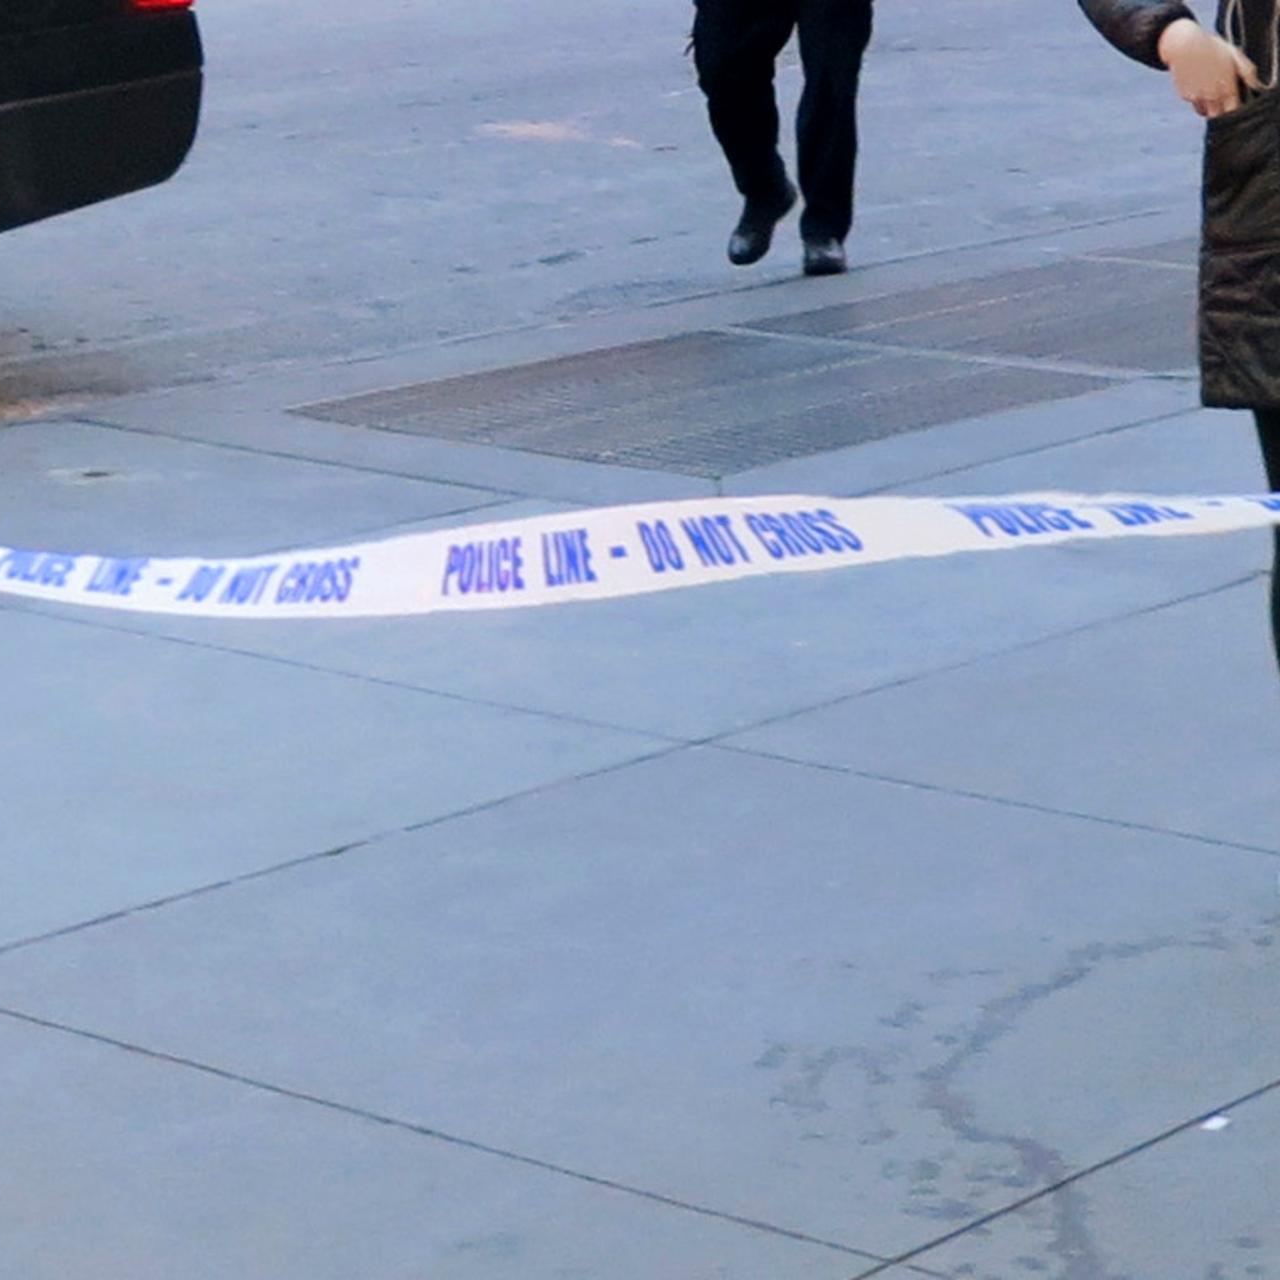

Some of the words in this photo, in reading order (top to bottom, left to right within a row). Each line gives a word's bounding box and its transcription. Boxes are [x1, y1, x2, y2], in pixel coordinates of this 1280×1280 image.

[441, 535, 526, 596] POLICE
[541, 528, 598, 588] LINE
[636, 518, 685, 573] DO
[679, 512, 752, 568] NOT
[746, 508, 864, 561] CROSS
